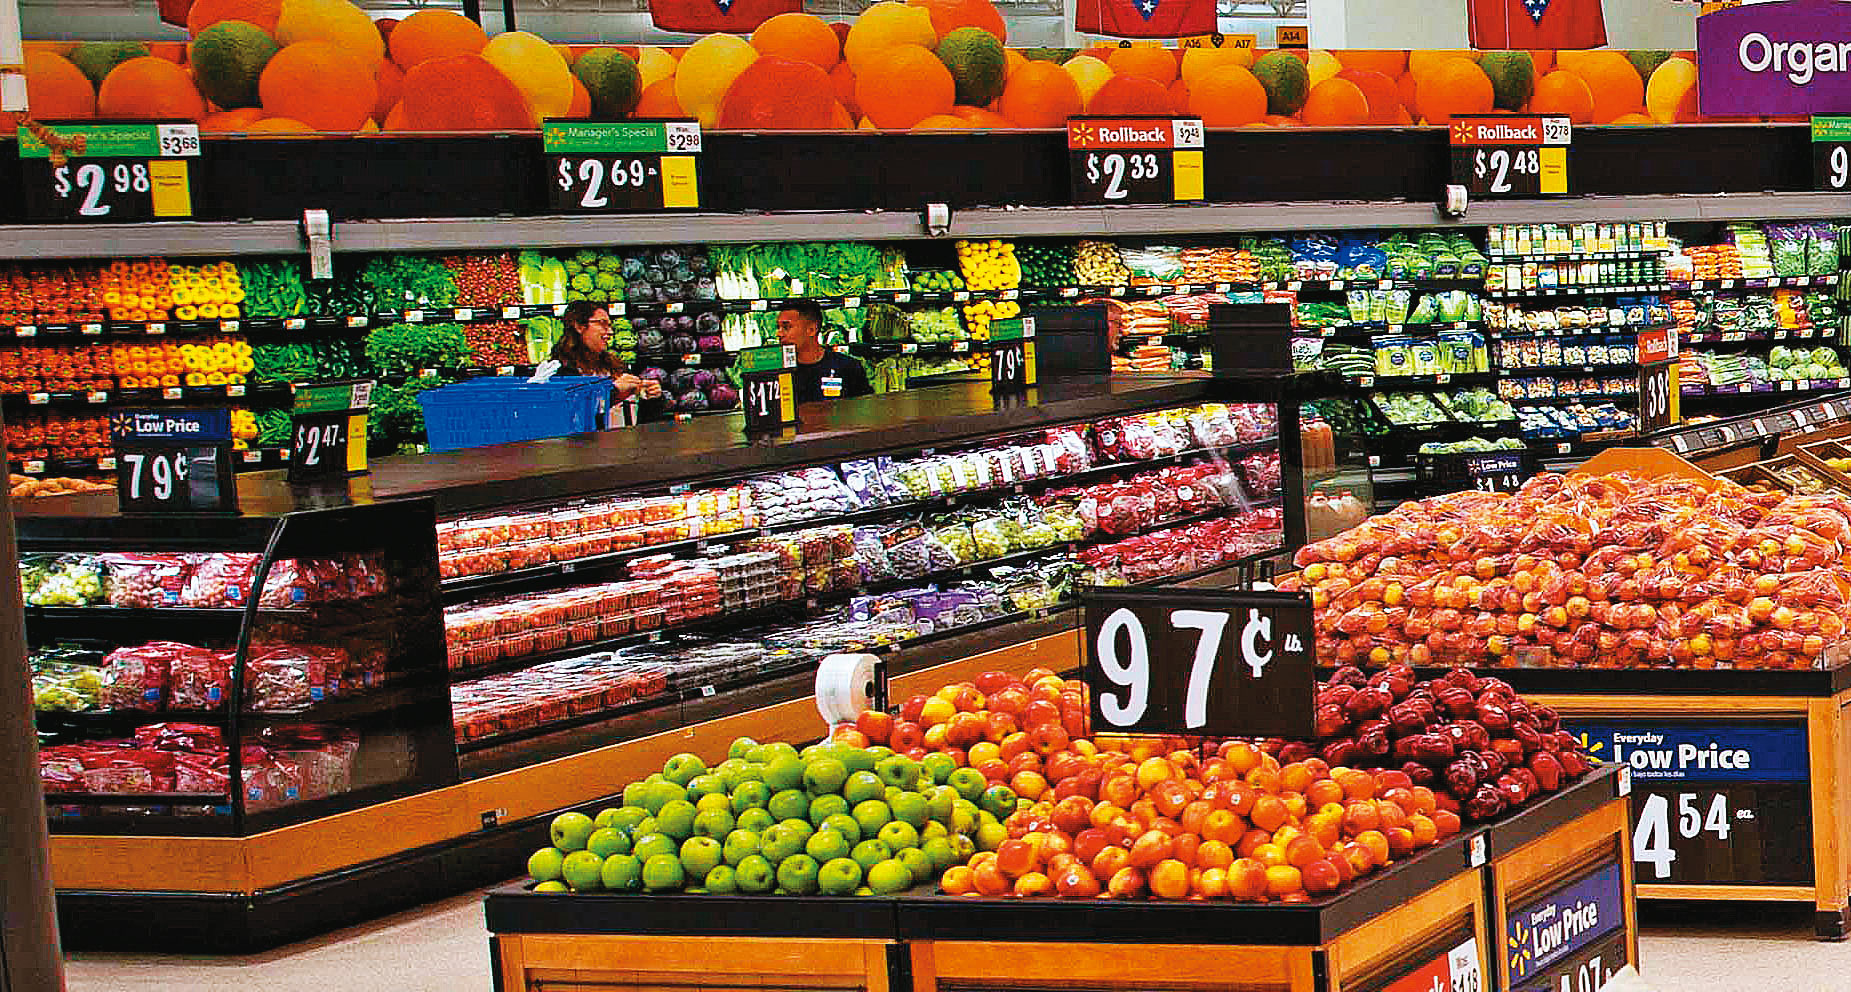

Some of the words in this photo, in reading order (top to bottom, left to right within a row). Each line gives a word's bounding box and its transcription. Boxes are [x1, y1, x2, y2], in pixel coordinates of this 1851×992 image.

[1099, 128, 1166, 142] Rollback
[1477, 125, 1537, 140] Rollback
[54, 164, 149, 215] $298
[559, 158, 644, 208] $269
[1087, 153, 1159, 199] $233
[1475, 149, 1540, 193] $248
[136, 420, 163, 433] Low
[167, 419, 200, 433] Price
[124, 452, 188, 500] 79¢
[1097, 607, 1272, 729] 97¢
[1613, 732, 1664, 745] Everyday
[1678, 742, 1750, 769] Price
[1532, 920, 1563, 957] Low
[1562, 900, 1598, 941] Price
